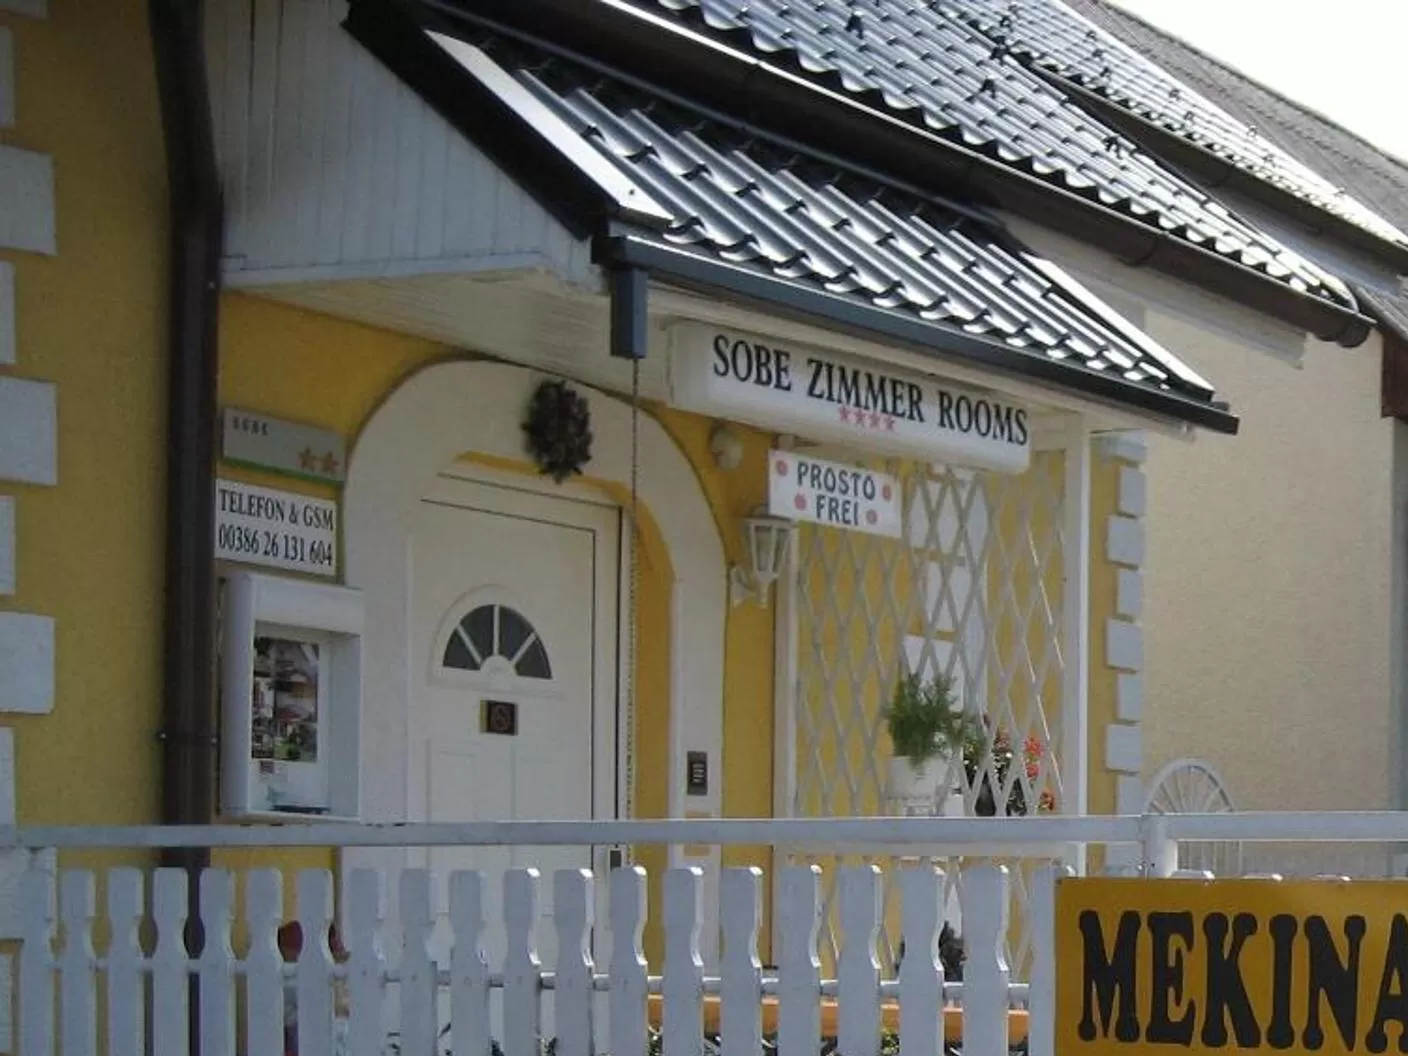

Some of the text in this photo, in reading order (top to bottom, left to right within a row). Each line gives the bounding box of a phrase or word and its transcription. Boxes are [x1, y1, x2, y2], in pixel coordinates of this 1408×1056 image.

[713, 334, 1027, 446] SOBE ZIMMER ROOMS
[797, 461, 876, 501] PROSTO
[219, 488, 334, 532] TELEFON & GSM
[816, 495, 859, 527] FREI
[218, 523, 333, 567] 00386 26 131 604
